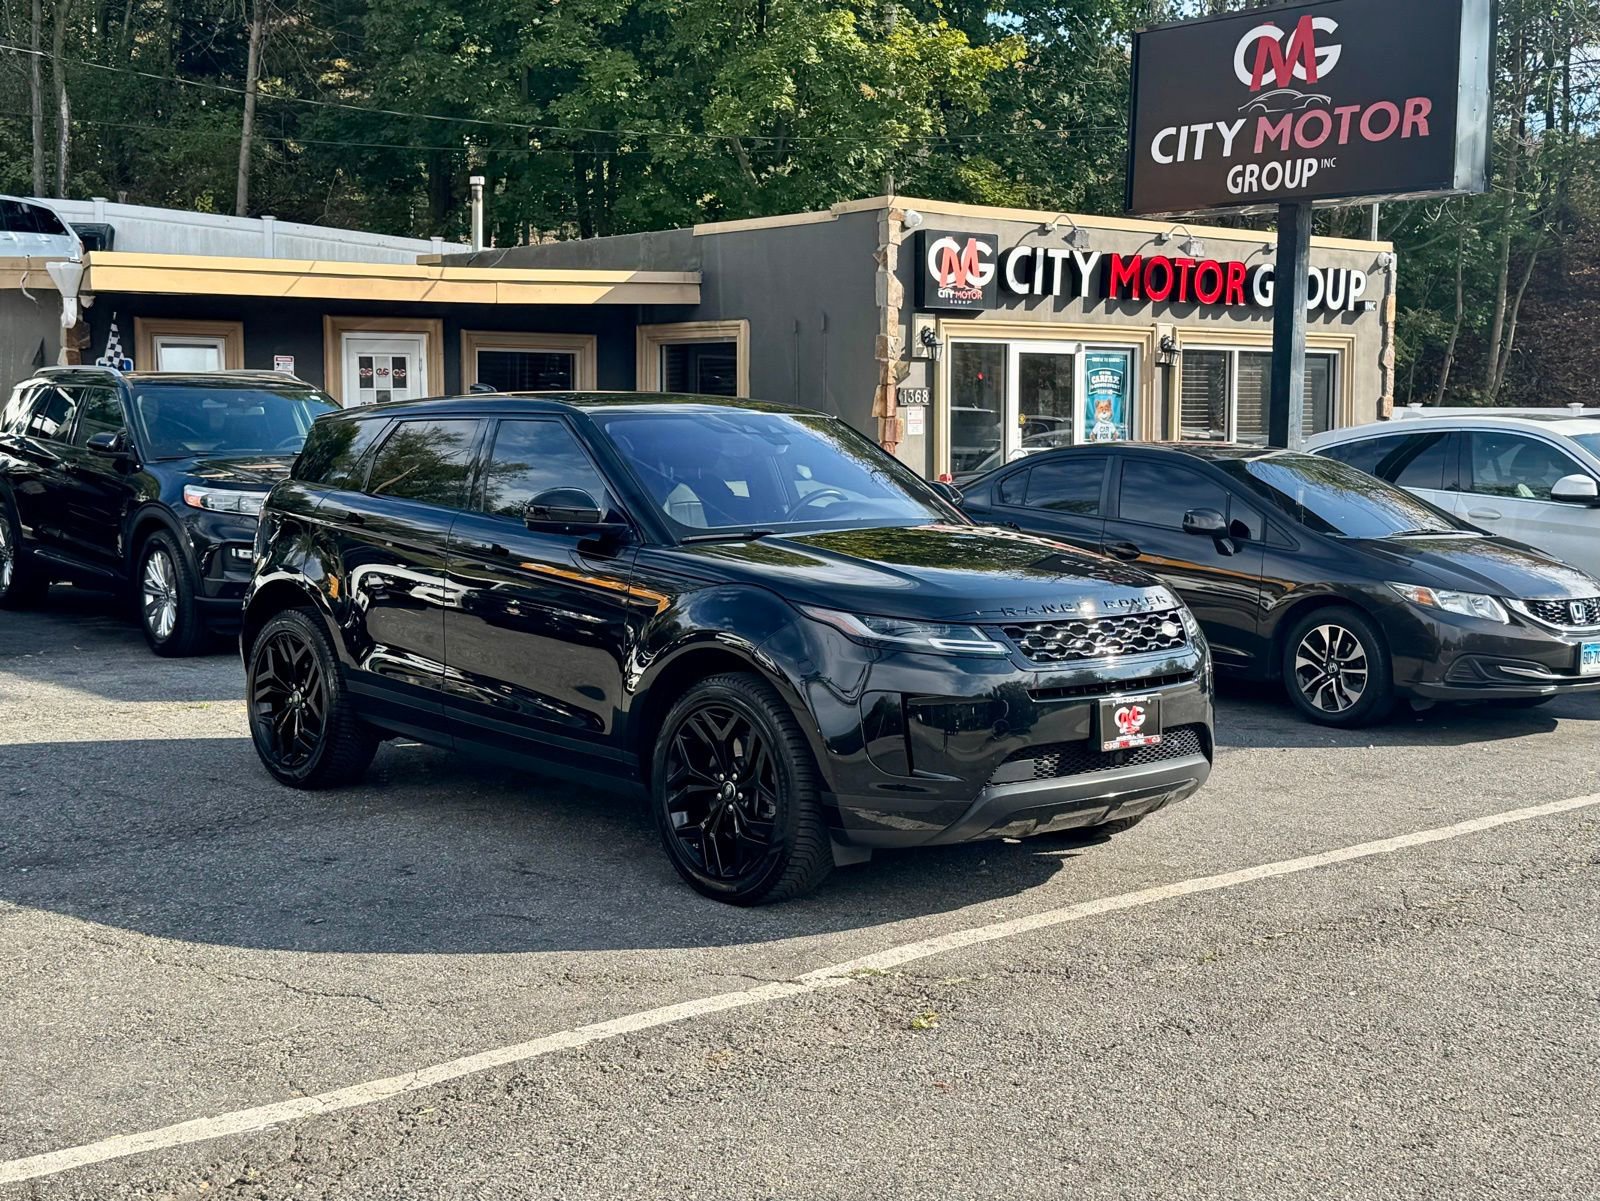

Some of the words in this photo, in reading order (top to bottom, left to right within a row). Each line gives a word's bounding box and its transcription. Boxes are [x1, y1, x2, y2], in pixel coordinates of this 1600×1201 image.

[1150, 118, 1246, 165] CITY
[1253, 97, 1432, 154] MOTOR
[1226, 158, 1318, 194] GROUP
[1320, 157, 1337, 169] INC
[1005, 246, 1102, 297] CITY
[1108, 252, 1247, 307] MOTOR
[1253, 263, 1367, 311] GOUP
[903, 389, 929, 403] 1368
[1103, 594, 1168, 609] ROVER
